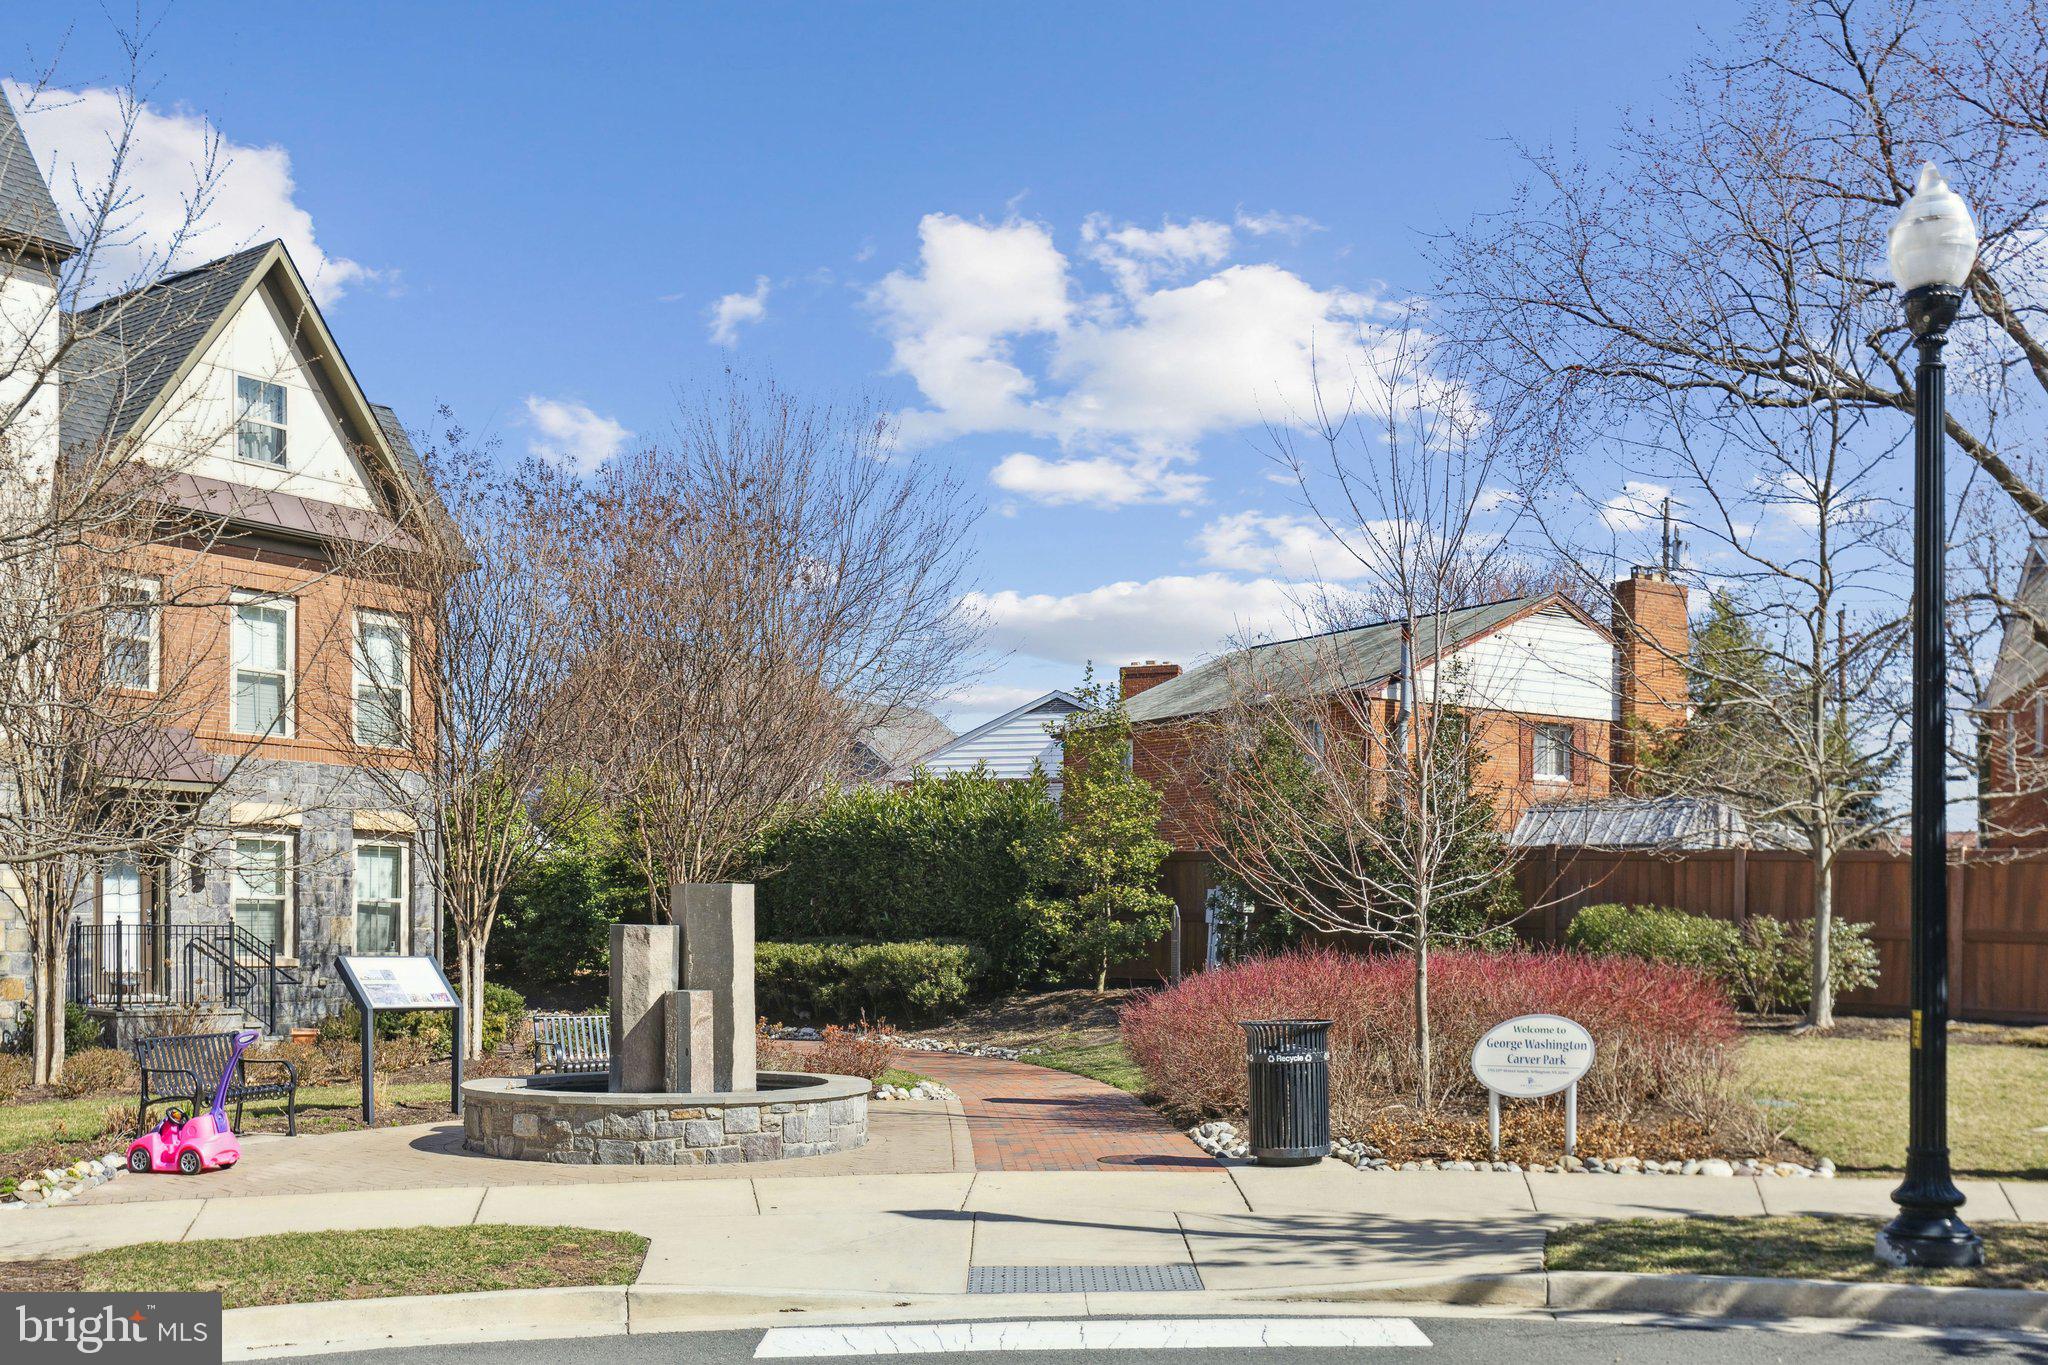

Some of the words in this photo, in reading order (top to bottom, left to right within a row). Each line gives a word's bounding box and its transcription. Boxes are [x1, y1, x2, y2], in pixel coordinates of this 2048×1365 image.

[1513, 1025, 1555, 1034] Welcome
[1556, 1026, 1567, 1034] to
[1486, 1038, 1523, 1050] George
[1524, 1039, 1587, 1052] Washington
[1276, 1054, 1304, 1063] Recycle
[1507, 1054, 1541, 1065] Carver
[1543, 1055, 1566, 1065] Park
